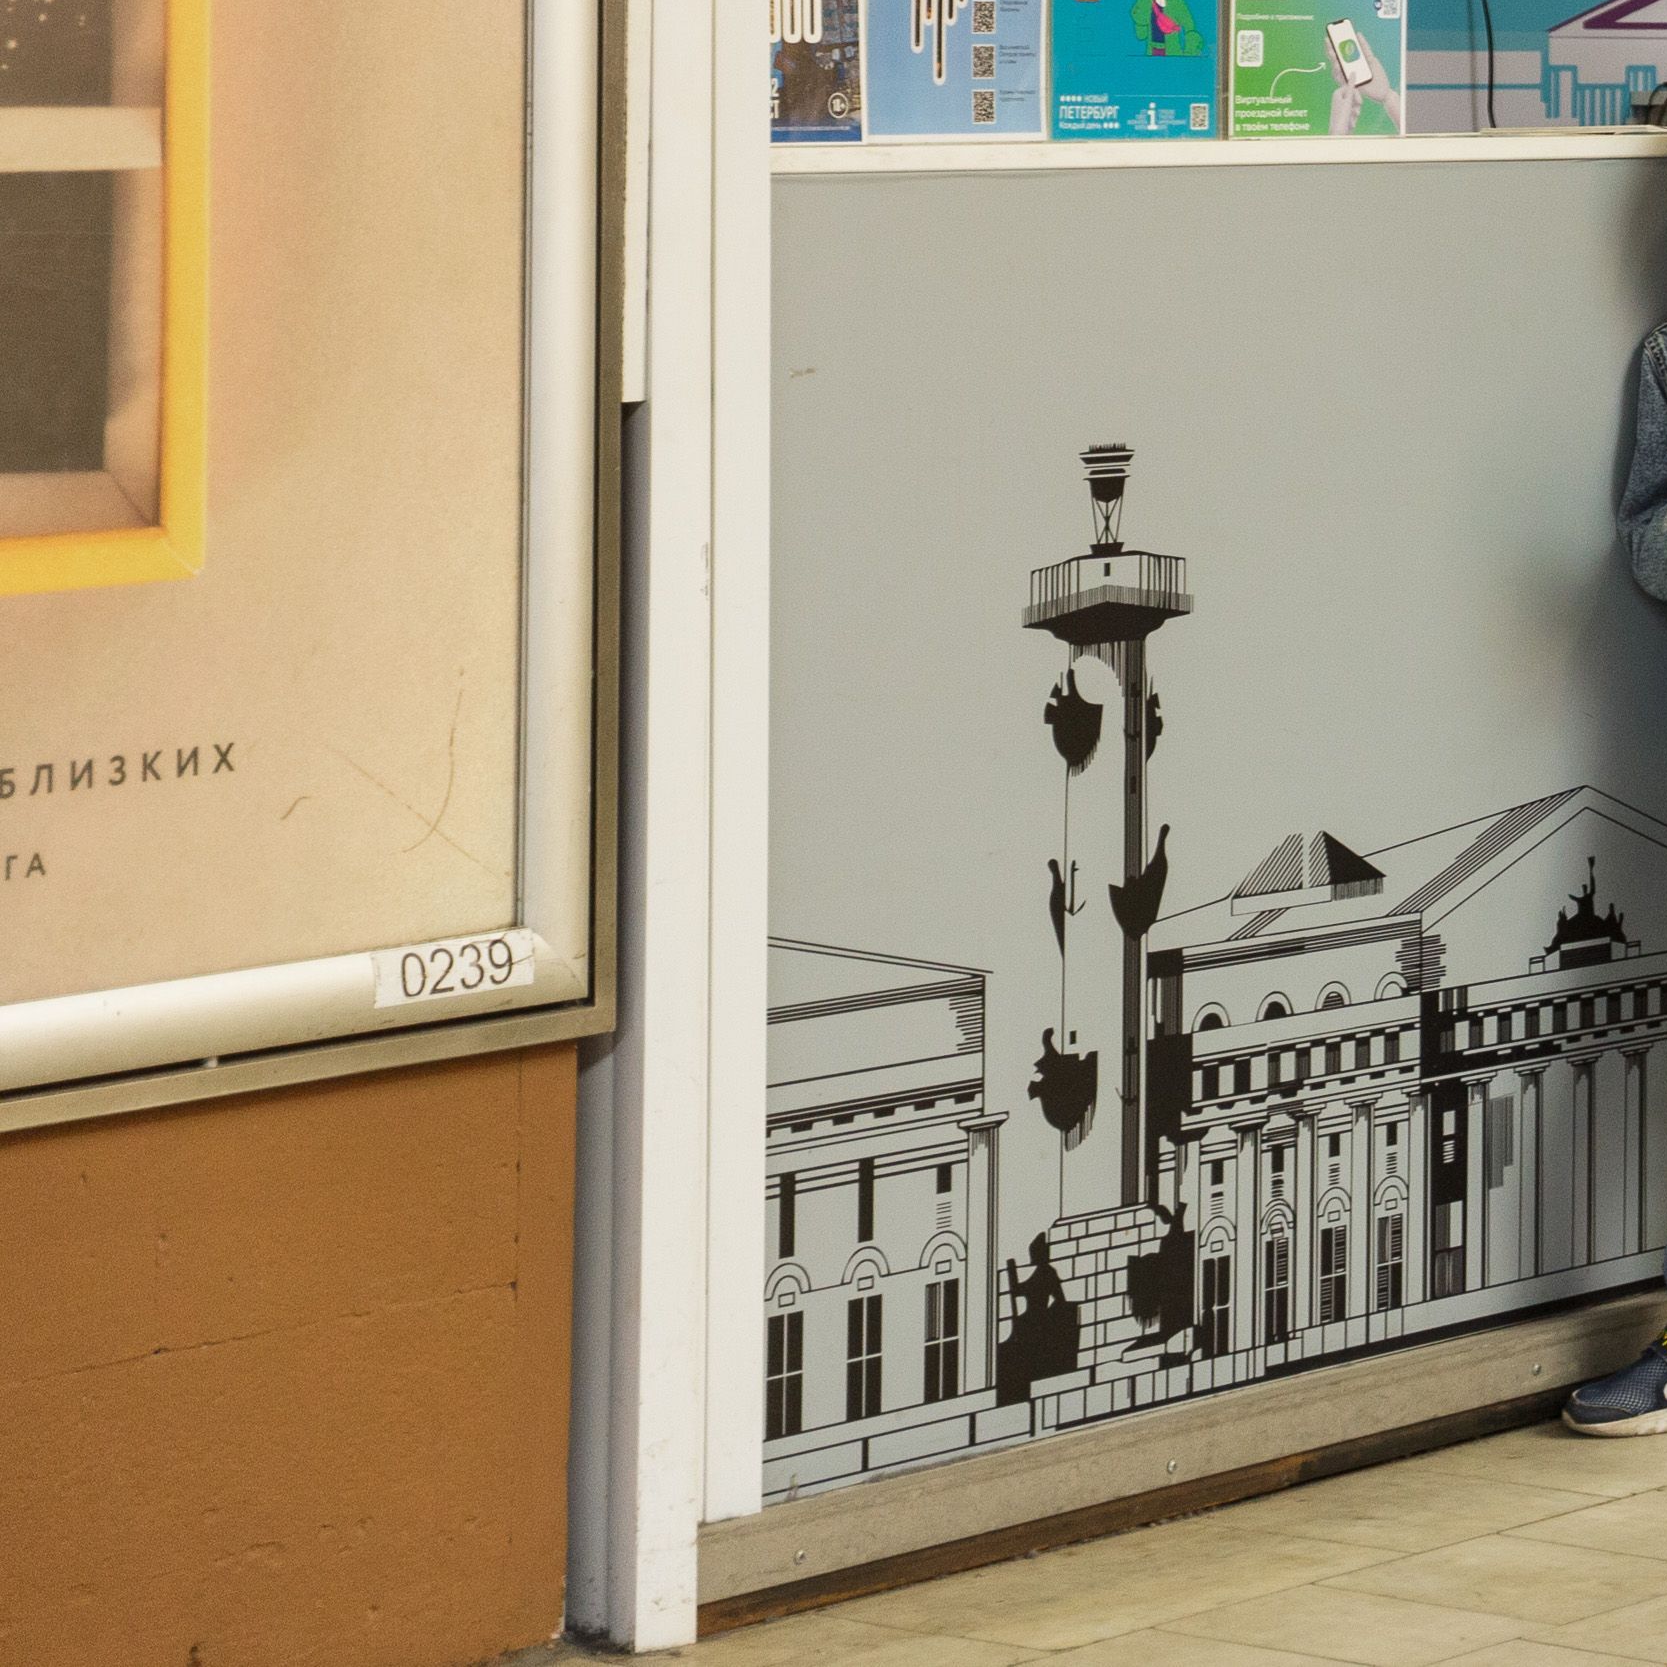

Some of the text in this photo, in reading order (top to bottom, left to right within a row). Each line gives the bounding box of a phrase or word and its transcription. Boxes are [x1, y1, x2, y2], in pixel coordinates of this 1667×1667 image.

[1059, 105, 1120, 120] ПЕТЕРБУРГ
[0, 742, 235, 800] БЛИЗКИХ
[401, 939, 513, 998] 0239
